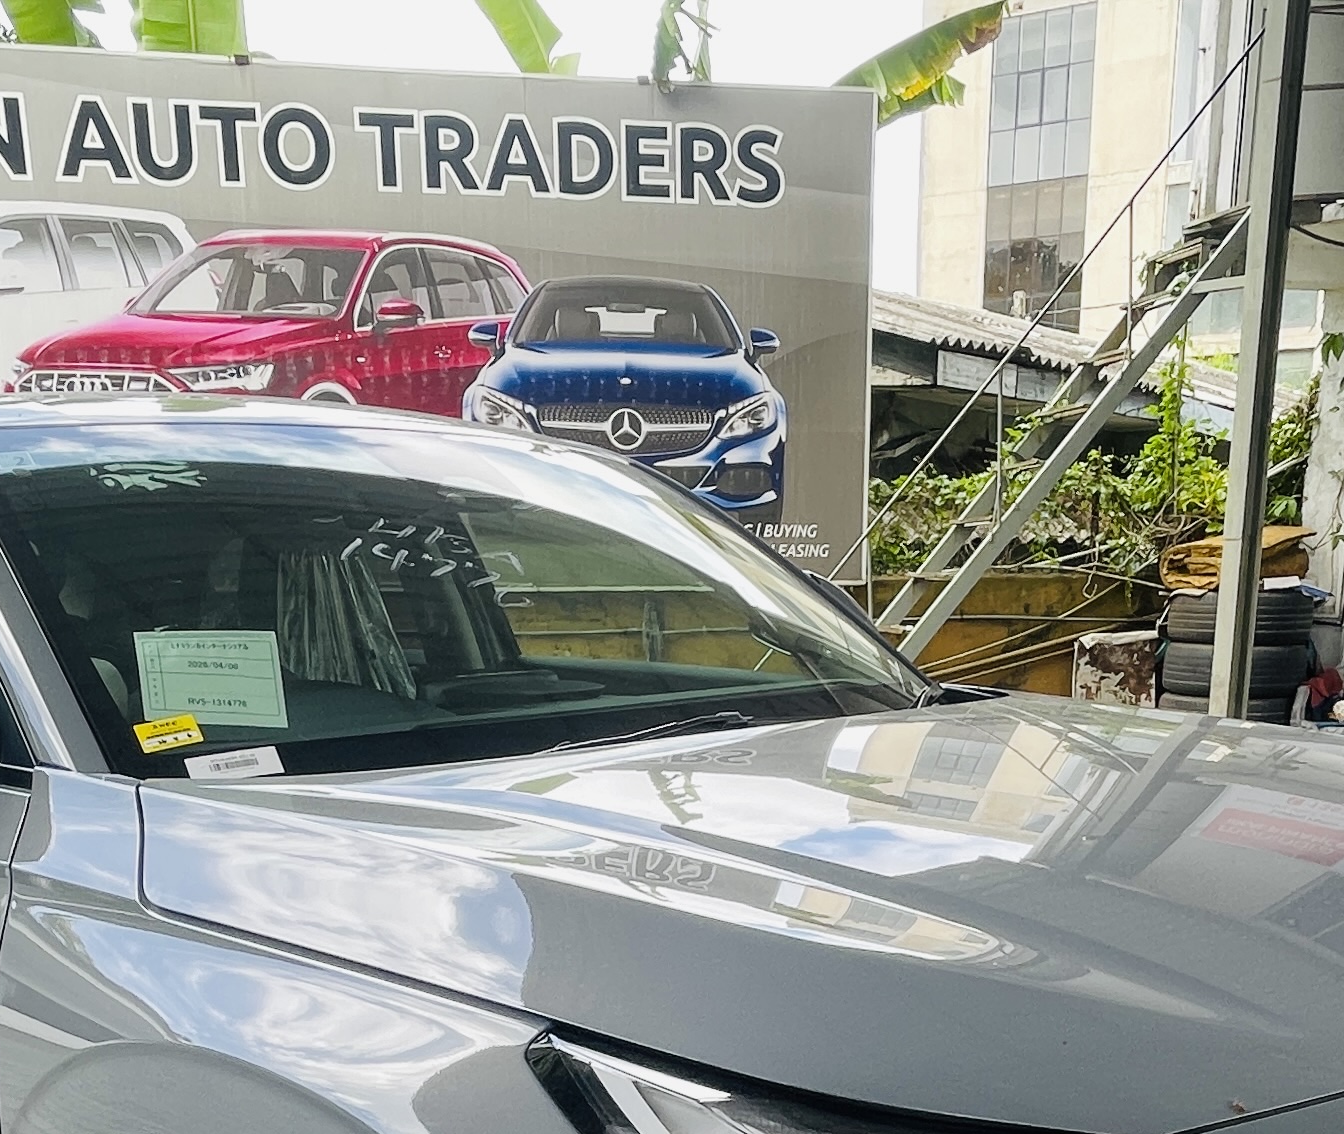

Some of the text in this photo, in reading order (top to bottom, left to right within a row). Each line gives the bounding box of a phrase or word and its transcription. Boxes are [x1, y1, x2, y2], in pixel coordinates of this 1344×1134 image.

[56, 96, 337, 192] AUTO
[353, 105, 787, 208] TRADERS
[763, 522, 818, 539] BUYING
